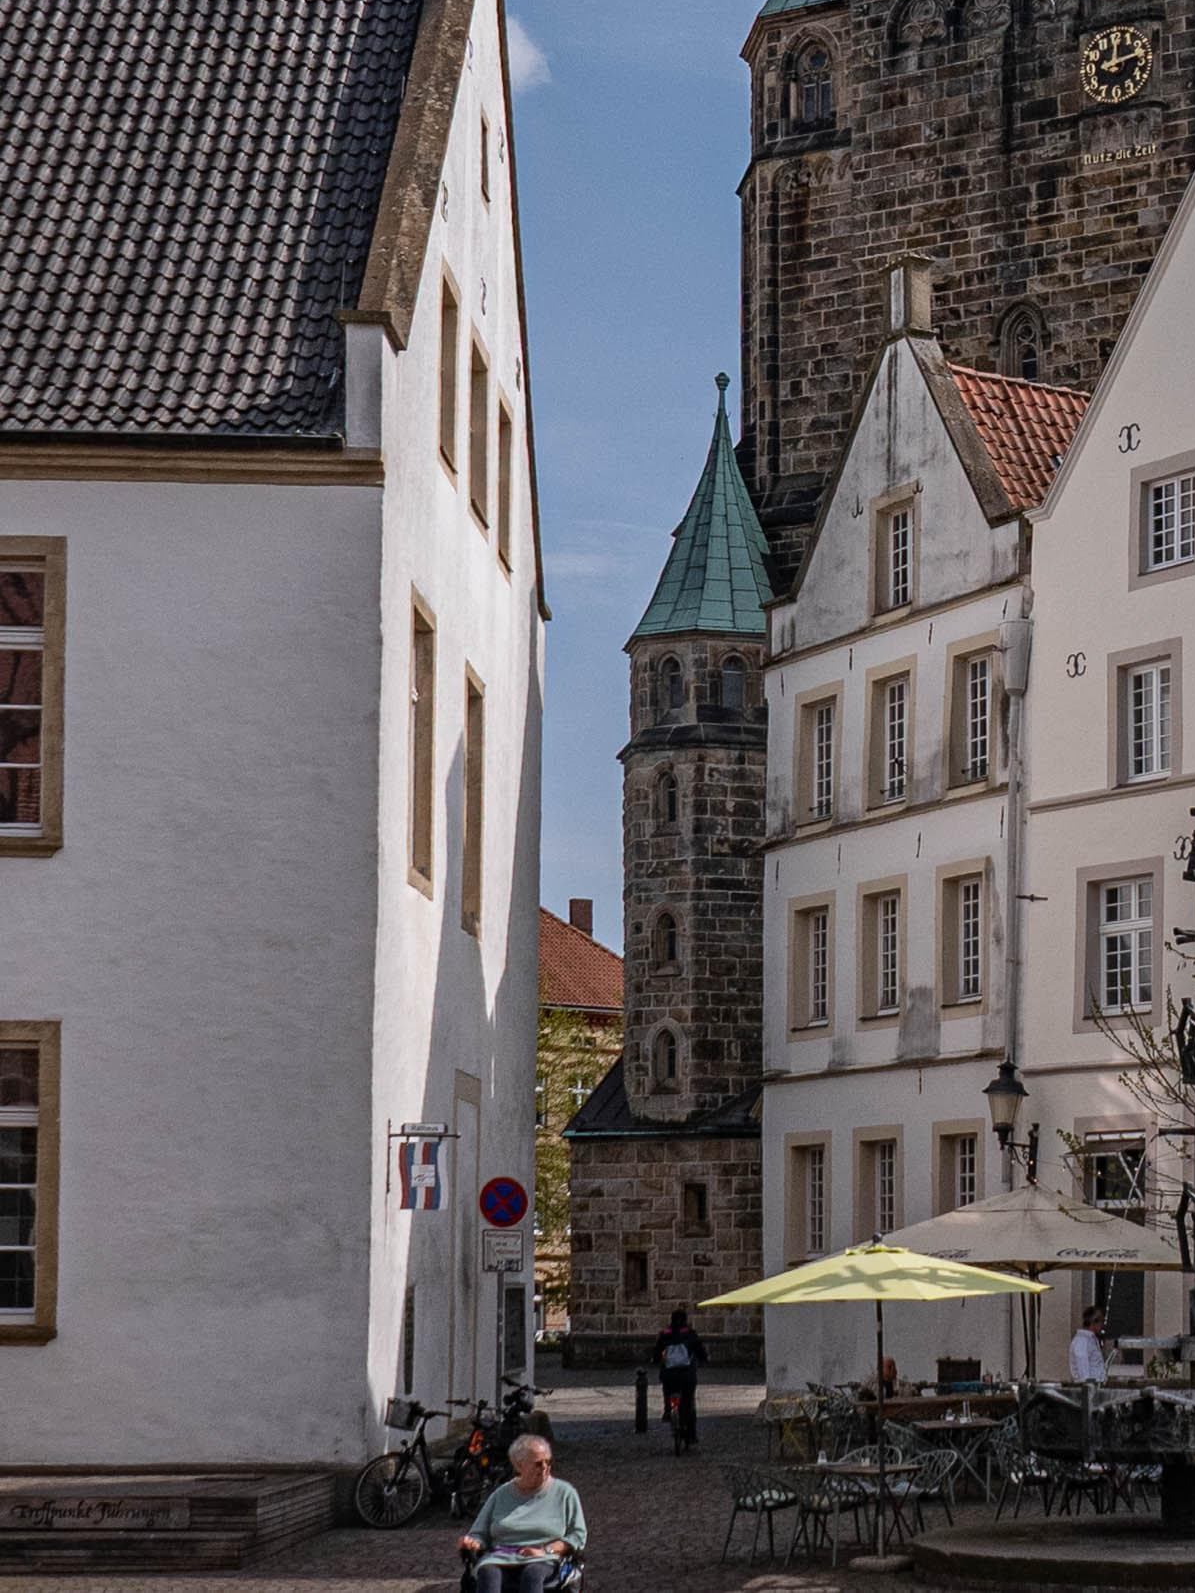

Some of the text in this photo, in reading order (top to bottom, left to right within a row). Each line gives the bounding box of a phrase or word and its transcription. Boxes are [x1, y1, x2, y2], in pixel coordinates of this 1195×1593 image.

[1098, 38, 1108, 50] 11
[1124, 33, 1132, 45] 1
[1089, 51, 1100, 62] 10
[1086, 63, 1096, 77] 9
[1133, 67, 1141, 80] 4
[1090, 76, 1099, 90] 8
[1124, 79, 1134, 94] 5
[1099, 85, 1108, 98] 7
[1112, 85, 1122, 98] 6
[1056, 1247, 1142, 1260] Coca-Cola
[9, 1499, 171, 1527] Treffpunkt Führungen
